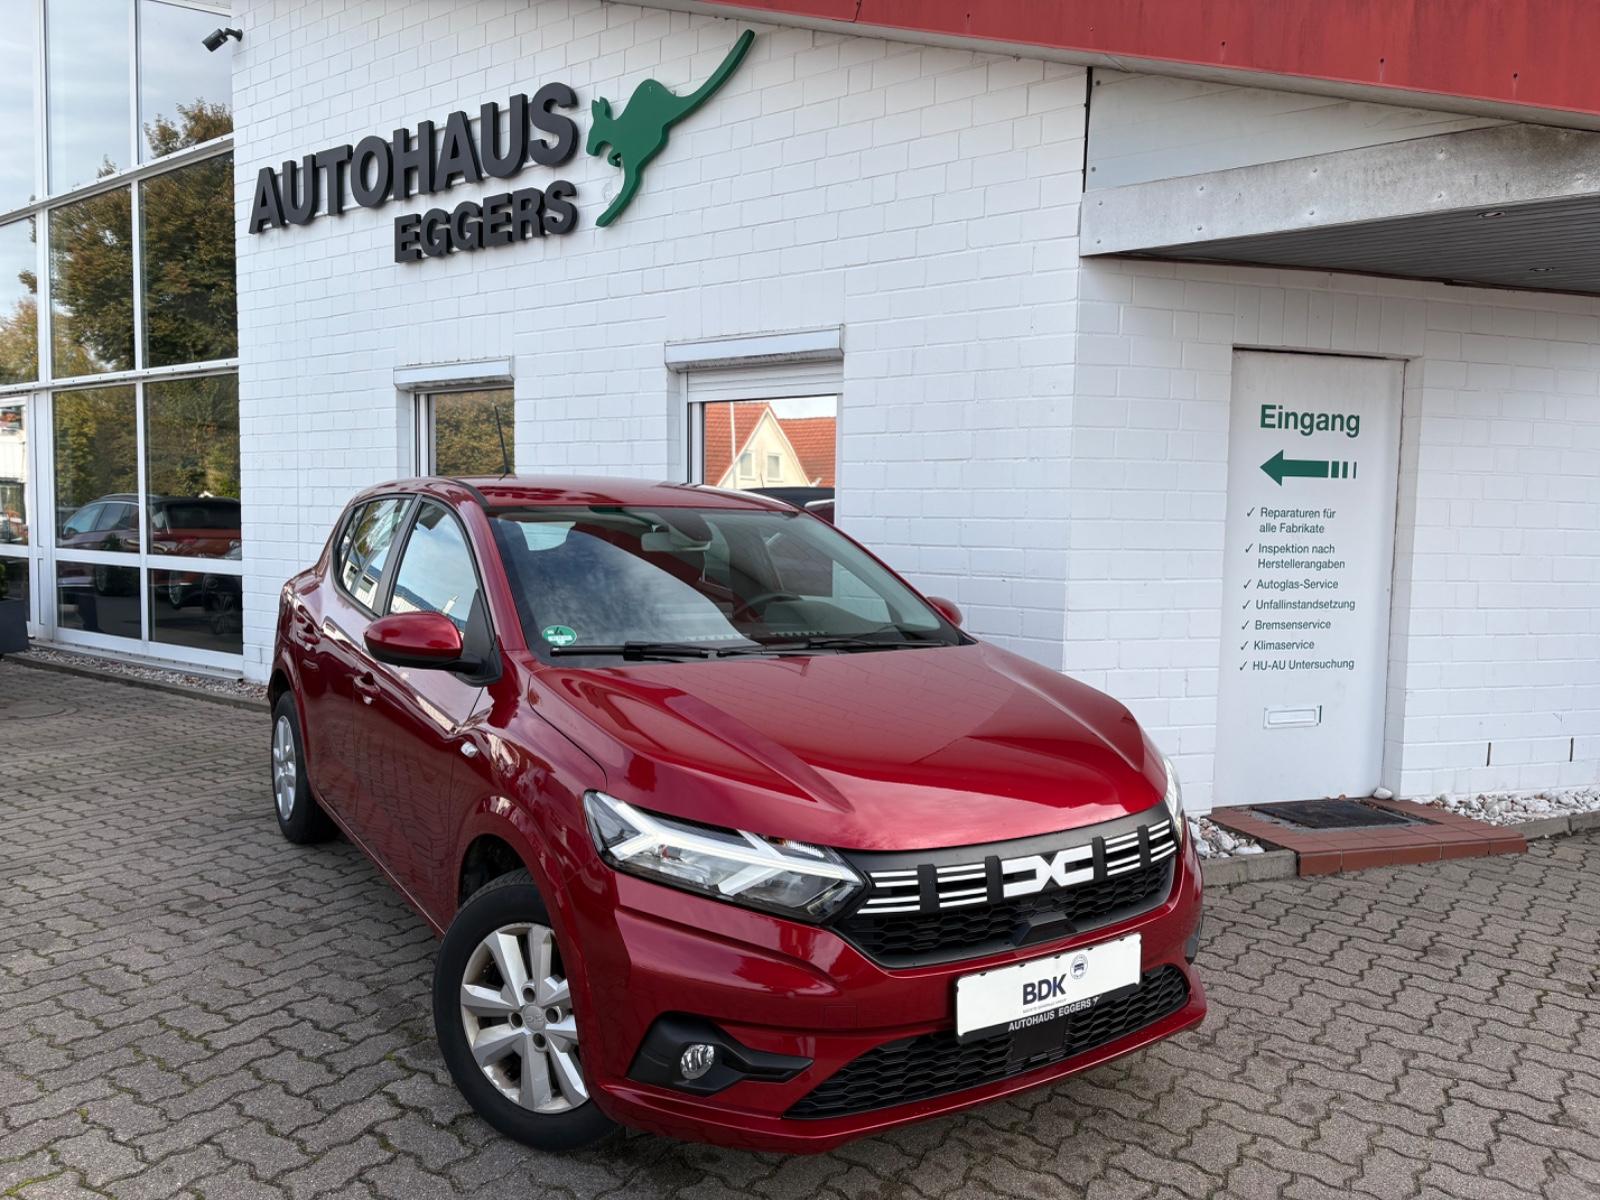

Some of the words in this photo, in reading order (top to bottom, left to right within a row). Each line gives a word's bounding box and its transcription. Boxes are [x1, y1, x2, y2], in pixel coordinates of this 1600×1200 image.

[248, 82, 578, 234] AUTOHAUS
[394, 180, 578, 263] EGGERS
[1260, 404, 1360, 438] Eingang
[1260, 507, 1320, 520] Reparaturen
[1323, 508, 1336, 519] für
[1259, 523, 1277, 533] alle
[1279, 523, 1325, 534] Fabrikate
[1258, 544, 1309, 556] Inspektion
[1311, 544, 1335, 554] nach
[1257, 559, 1345, 571] Herstellerangaben
[1256, 579, 1339, 591] Autoglas-Service
[1255, 599, 1356, 611] Unfallinstandsetzung
[1254, 619, 1331, 630] Bremsenservice
[1253, 639, 1315, 650] Klimaservice
[1252, 660, 1286, 671] HU-AU
[1289, 659, 1355, 671] Untersuchung
[1022, 973, 1067, 1006] BDK
[1008, 1010, 1055, 1032] AUTOHAUS
[1058, 999, 1091, 1017] EGGERS
